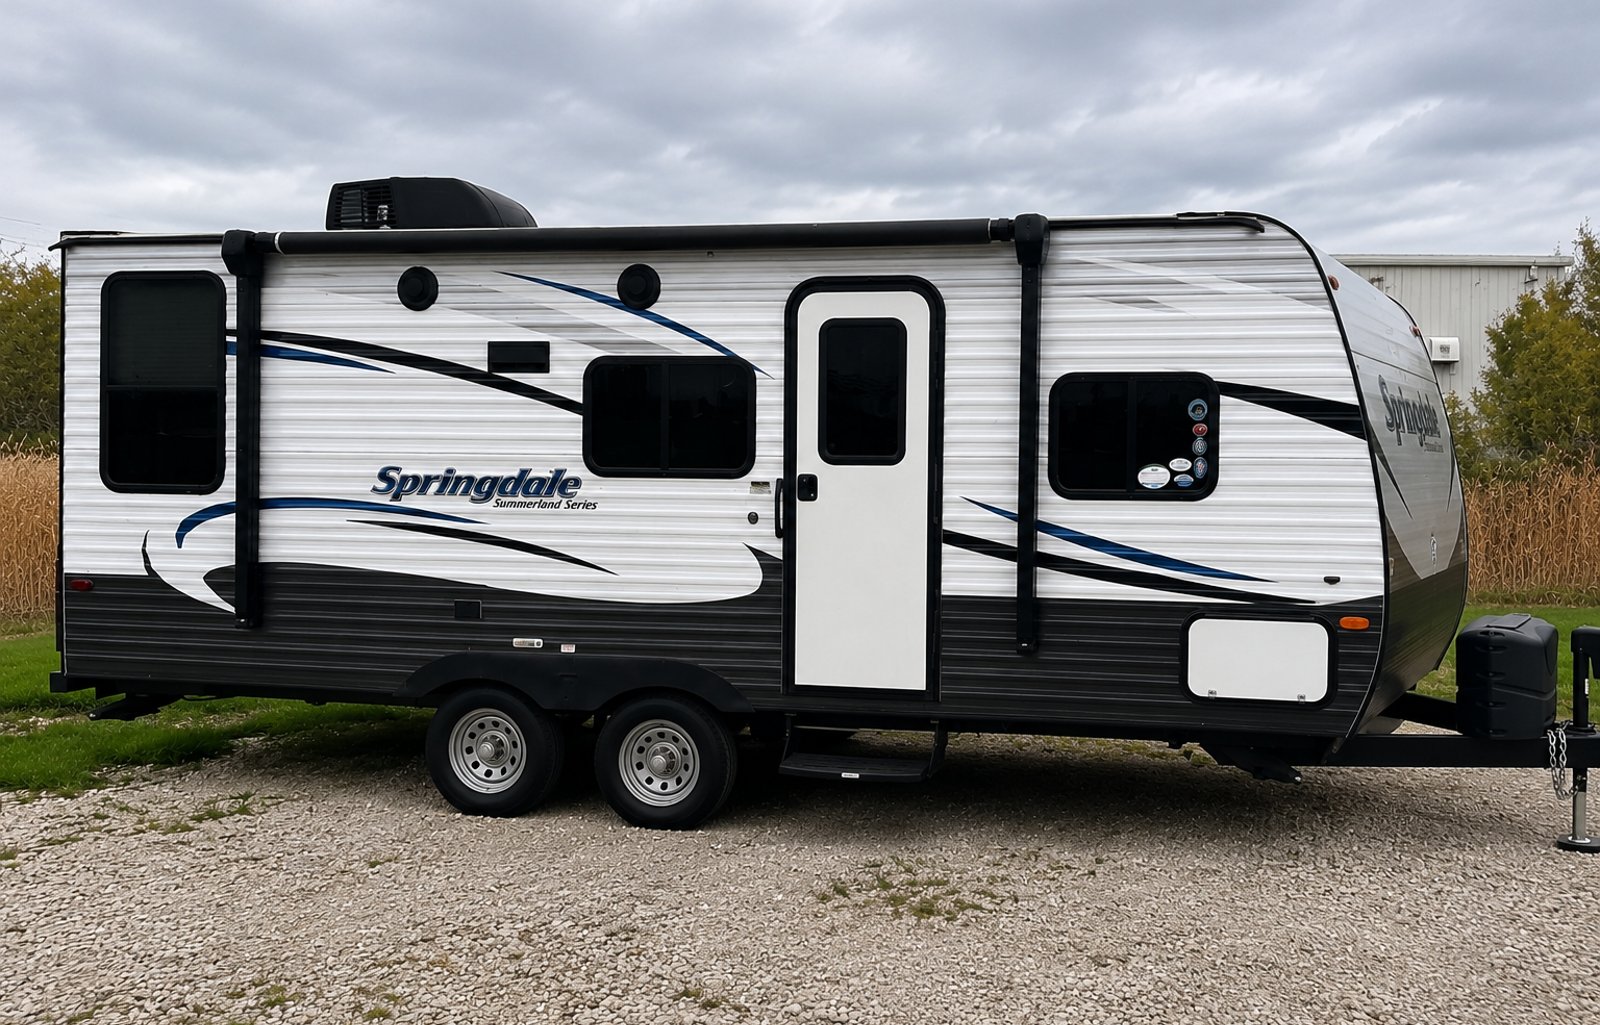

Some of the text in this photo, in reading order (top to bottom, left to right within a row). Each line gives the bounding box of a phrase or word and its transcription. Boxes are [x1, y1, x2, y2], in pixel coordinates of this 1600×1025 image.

[370, 465, 583, 503] Springdale
[492, 498, 598, 510] Summerland Series
